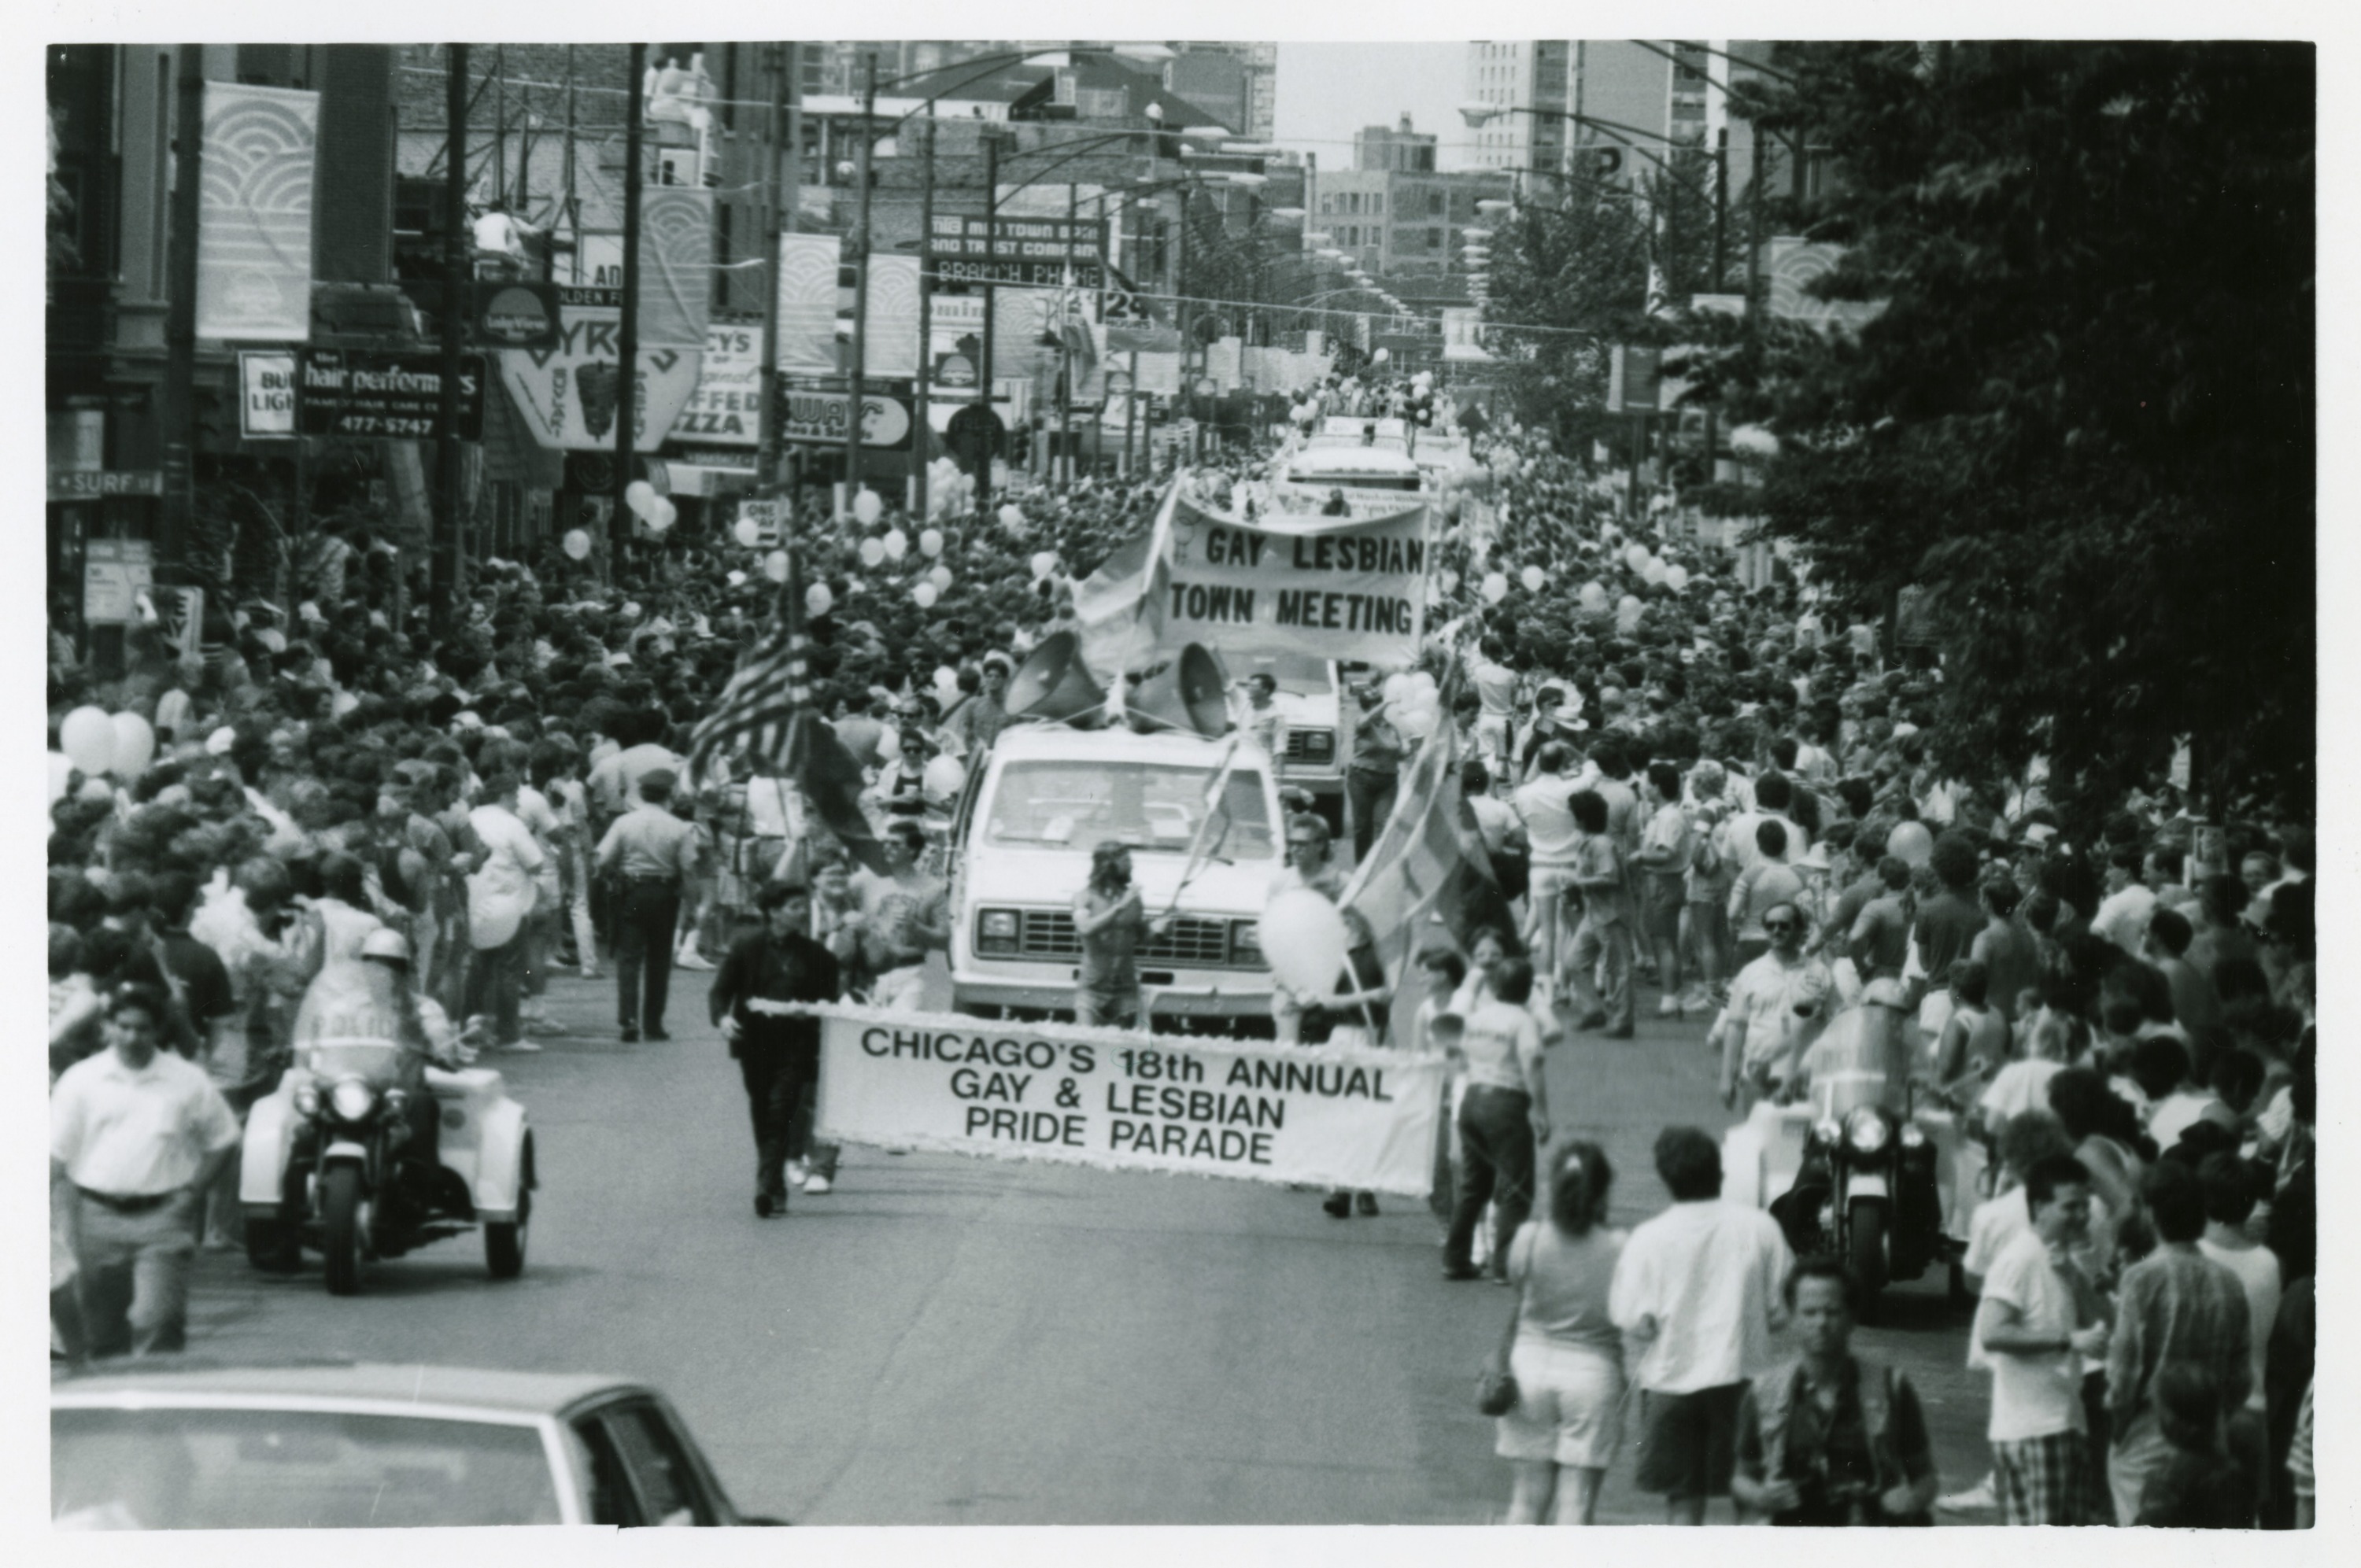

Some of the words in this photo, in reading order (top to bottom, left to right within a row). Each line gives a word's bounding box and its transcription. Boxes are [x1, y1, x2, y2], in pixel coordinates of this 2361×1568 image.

[1007, 223, 1053, 238] TOWN
[966, 238, 1018, 253] TRST
[1034, 265, 1098, 286] PHNE
[560, 290, 603, 305] LDEN
[305, 360, 349, 388] hair
[353, 364, 477, 395] performs
[72, 474, 133, 493] SURF
[748, 504, 776, 517] ONE
[1206, 528, 1265, 567] GAY
[1292, 535, 1424, 574] LESBIAN
[1170, 582, 1255, 623] TOWN
[1276, 588, 1413, 635] MEETING
[862, 1028, 1096, 1074] CHICAGO'S
[1118, 1050, 1204, 1083] 18th
[1227, 1057, 1394, 1101] ANNUAL
[951, 1068, 1033, 1102] GAY
[1055, 1077, 1081, 1109] &
[1107, 1082, 1285, 1130] LESBIAN
[966, 1106, 1088, 1148] PRIDE
[1110, 1120, 1274, 1165] PARADE
